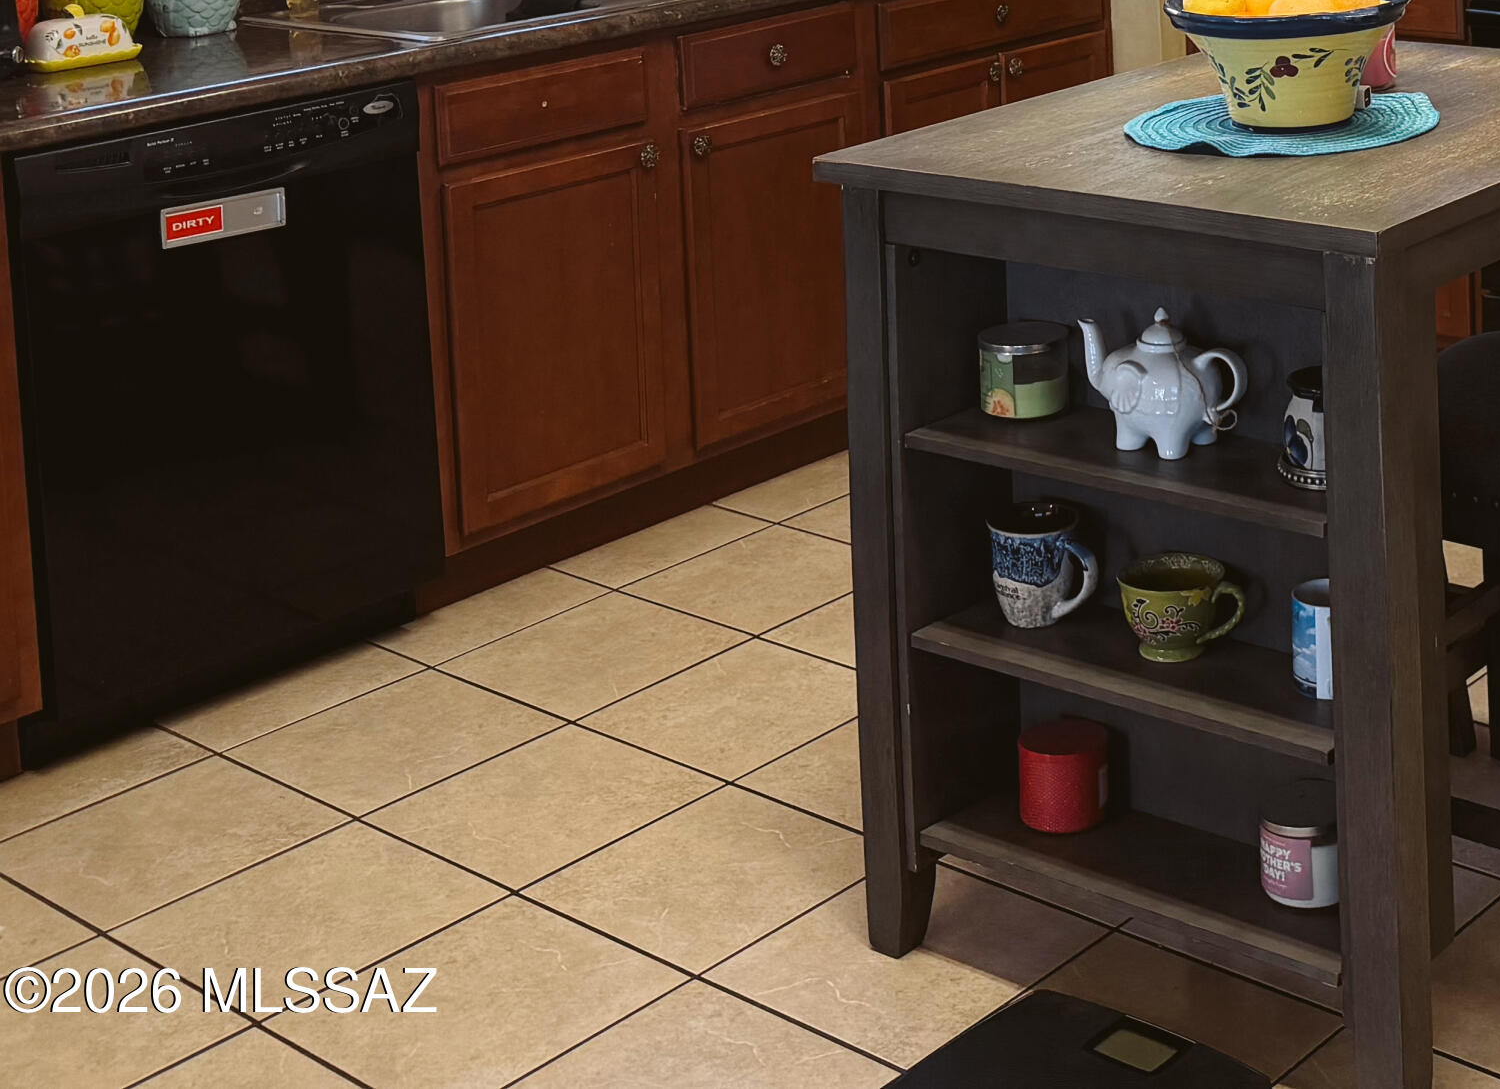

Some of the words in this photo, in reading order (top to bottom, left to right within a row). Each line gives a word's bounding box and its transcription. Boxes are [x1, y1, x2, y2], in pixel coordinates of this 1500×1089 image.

[172, 215, 215, 232] DIRTY
[1261, 838, 1291, 860] HAPPY
[1263, 864, 1286, 882] DAY!
